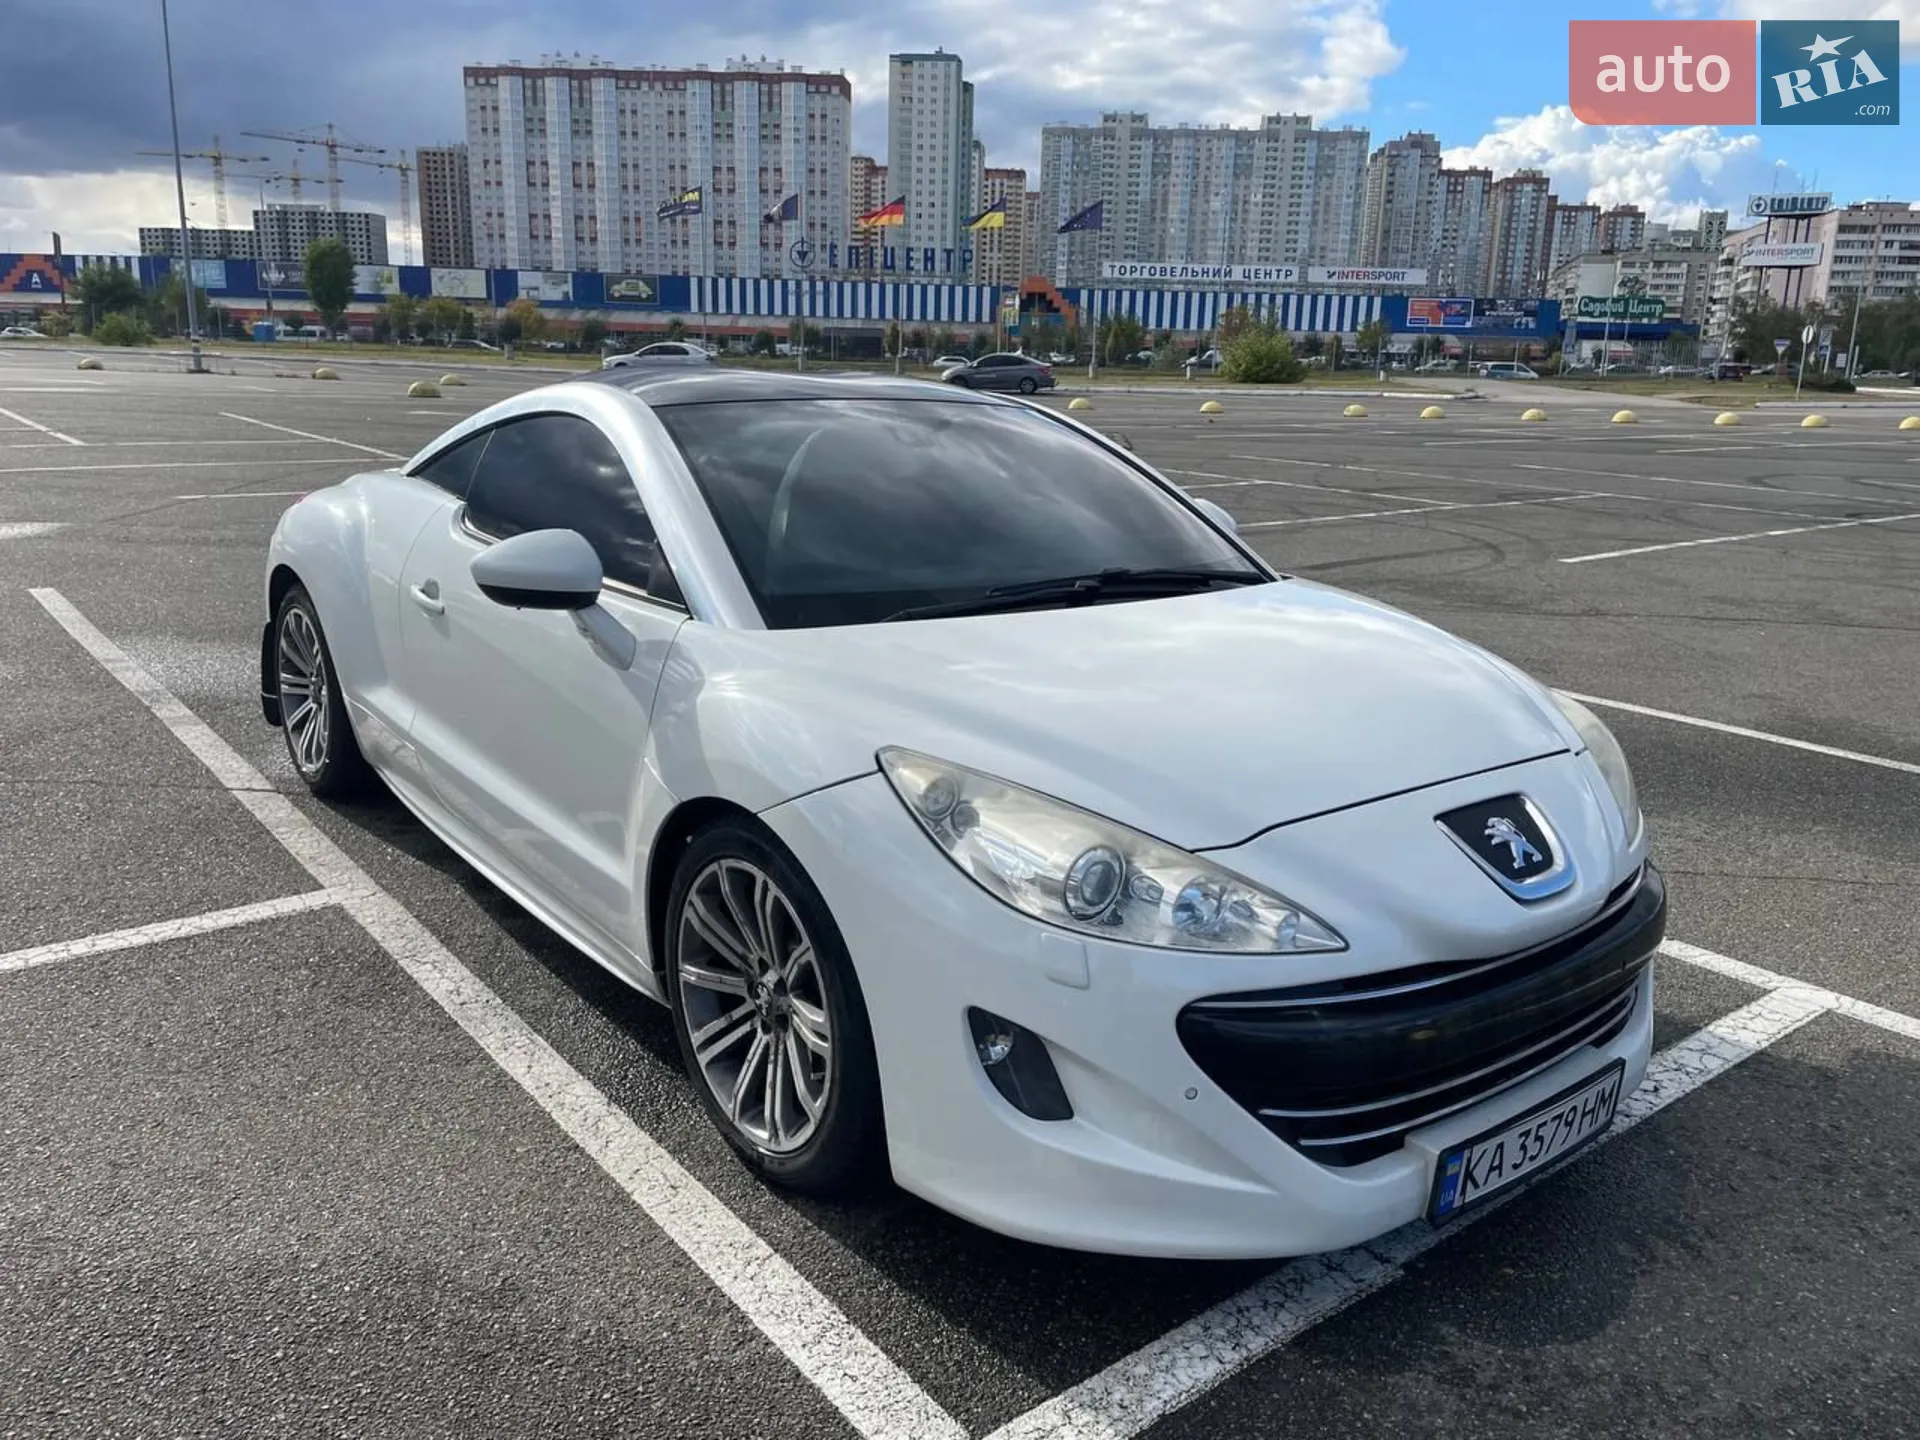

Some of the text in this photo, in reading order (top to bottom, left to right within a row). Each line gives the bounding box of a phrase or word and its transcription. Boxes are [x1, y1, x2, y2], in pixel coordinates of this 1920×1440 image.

[1108, 263, 1295, 282] ТОРГОВЕЛЬНИЙ ЦЕНТР
[1337, 270, 1408, 282] INTERSPORT
[1460, 1080, 1618, 1197] KA 3579 HM
